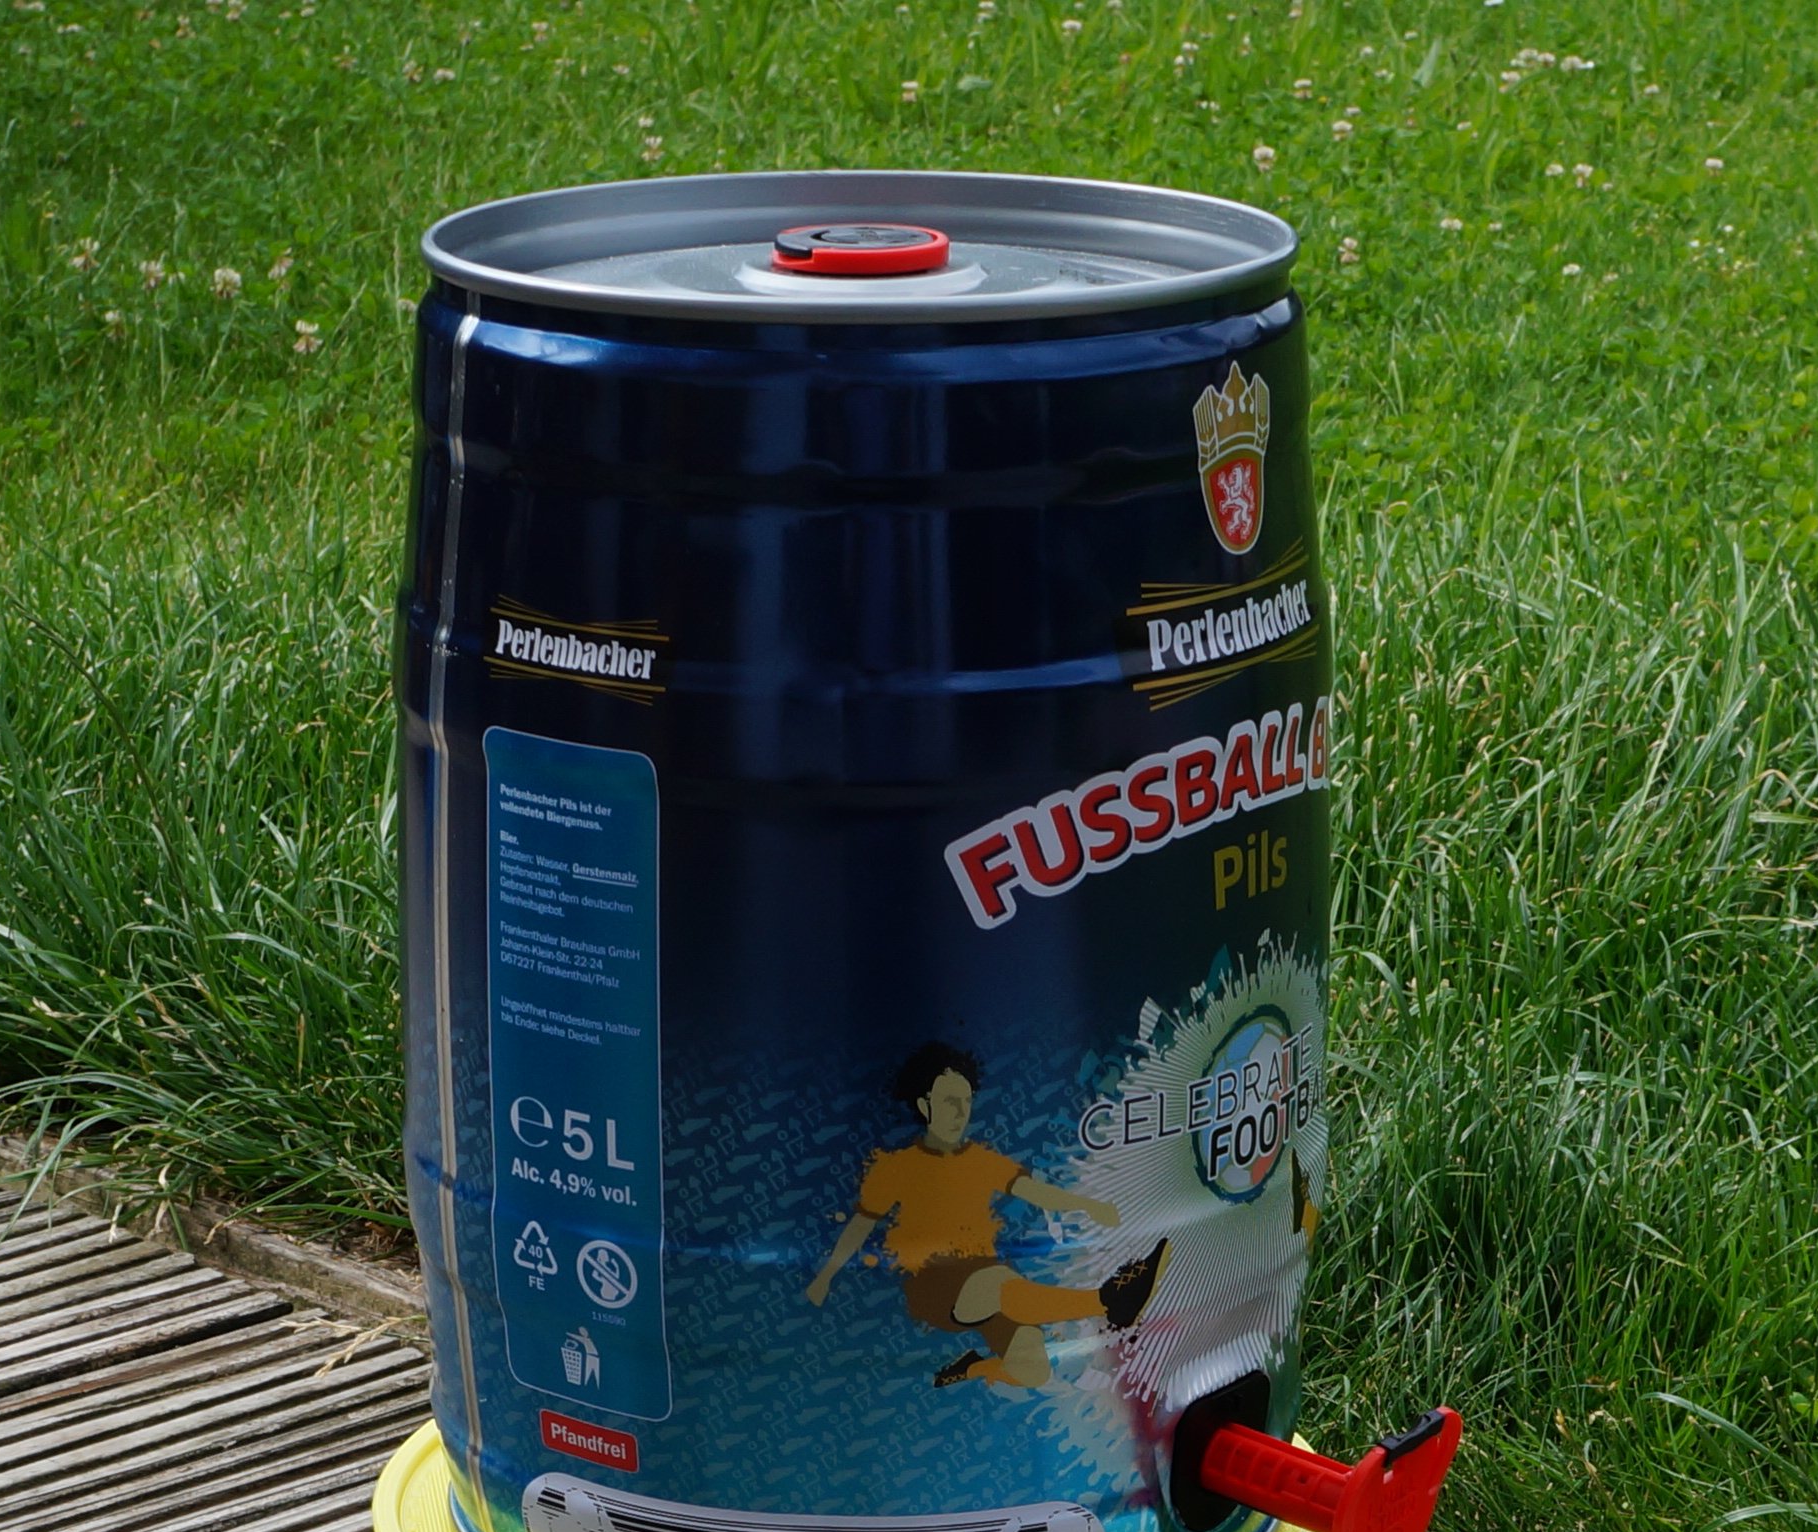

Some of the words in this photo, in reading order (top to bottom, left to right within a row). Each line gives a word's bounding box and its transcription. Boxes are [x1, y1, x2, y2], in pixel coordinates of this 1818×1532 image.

[1147, 578, 1313, 671] Perlenbacher
[495, 619, 656, 680] Perlenbacher
[500, 783, 557, 806] Perlenbacher
[560, 798, 578, 812] Pils
[580, 801, 593, 814] ist
[595, 804, 612, 817] der
[500, 801, 544, 820] vollendete
[547, 810, 603, 831] Biergenuss.
[956, 712, 1305, 921] FUSSBALL
[500, 830, 519, 845] Bier.
[500, 845, 534, 865] Zutaten:
[1213, 828, 1287, 911] Pils
[500, 876, 533, 896] Gebraut
[535, 886, 556, 900] nach
[559, 891, 579, 905] dem
[581, 894, 634, 914] deutschen
[500, 891, 565, 917] Reinheitsgebot.
[500, 920, 558, 946] Frankenthaler
[561, 936, 606, 956] Brauhaus
[608, 946, 641, 961] GmbH
[537, 961, 620, 988] Frankenthal/Pfalz
[501, 1011, 513, 1025] bis
[541, 1022, 566, 1038] siehe
[549, 1010, 603, 1031] mindestens
[605, 1021, 641, 1037] haltbar
[1080, 1026, 1312, 1151] CELEBRATE
[1207, 1068, 1324, 1180] FOOTBA
[511, 1157, 545, 1185] Alc.
[549, 1168, 596, 1198] 4,9%
[601, 1185, 637, 1207] vol.
[528, 1244, 543, 1259] 40
[528, 1275, 545, 1291] FE
[550, 1422, 627, 1460] Pfandfrei
